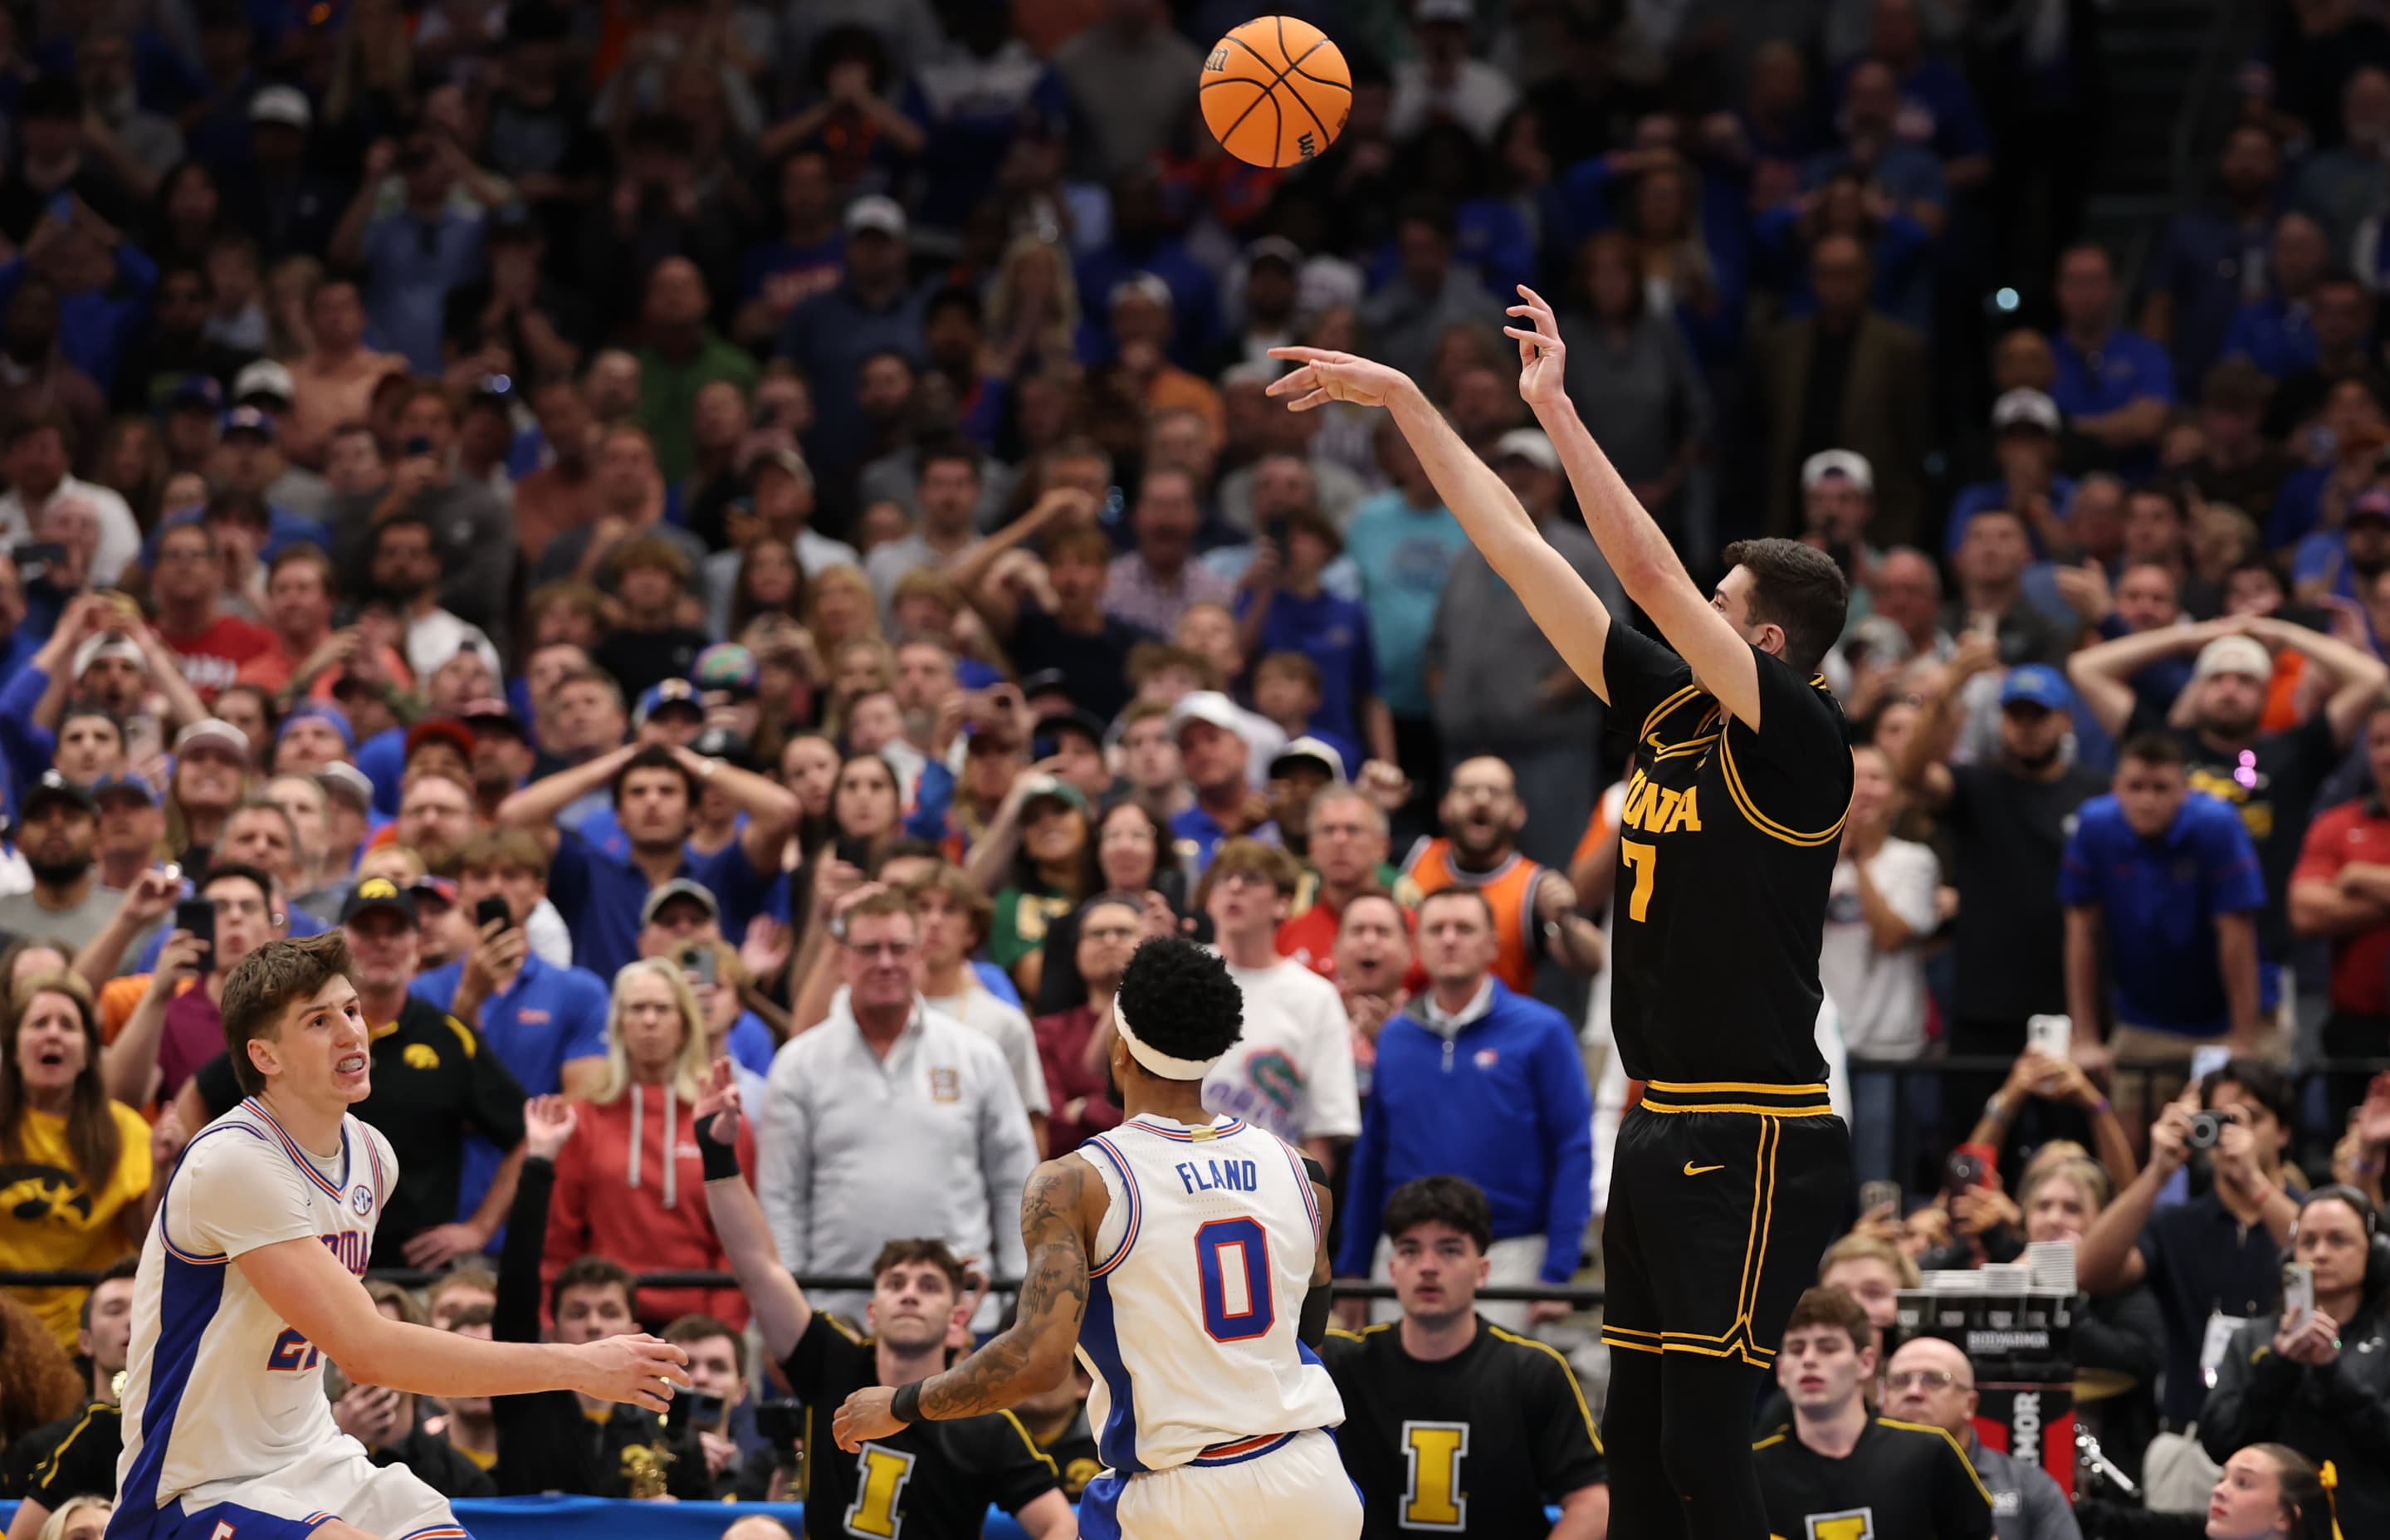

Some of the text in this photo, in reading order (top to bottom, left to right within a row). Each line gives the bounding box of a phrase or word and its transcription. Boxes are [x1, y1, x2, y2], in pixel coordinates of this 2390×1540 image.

[1621, 837, 1656, 922] 7
[1175, 1160, 1257, 1195] FLAND
[1194, 1215, 1275, 1342] 0
[843, 1441, 916, 1540] I
[1399, 1420, 1469, 1533] I
